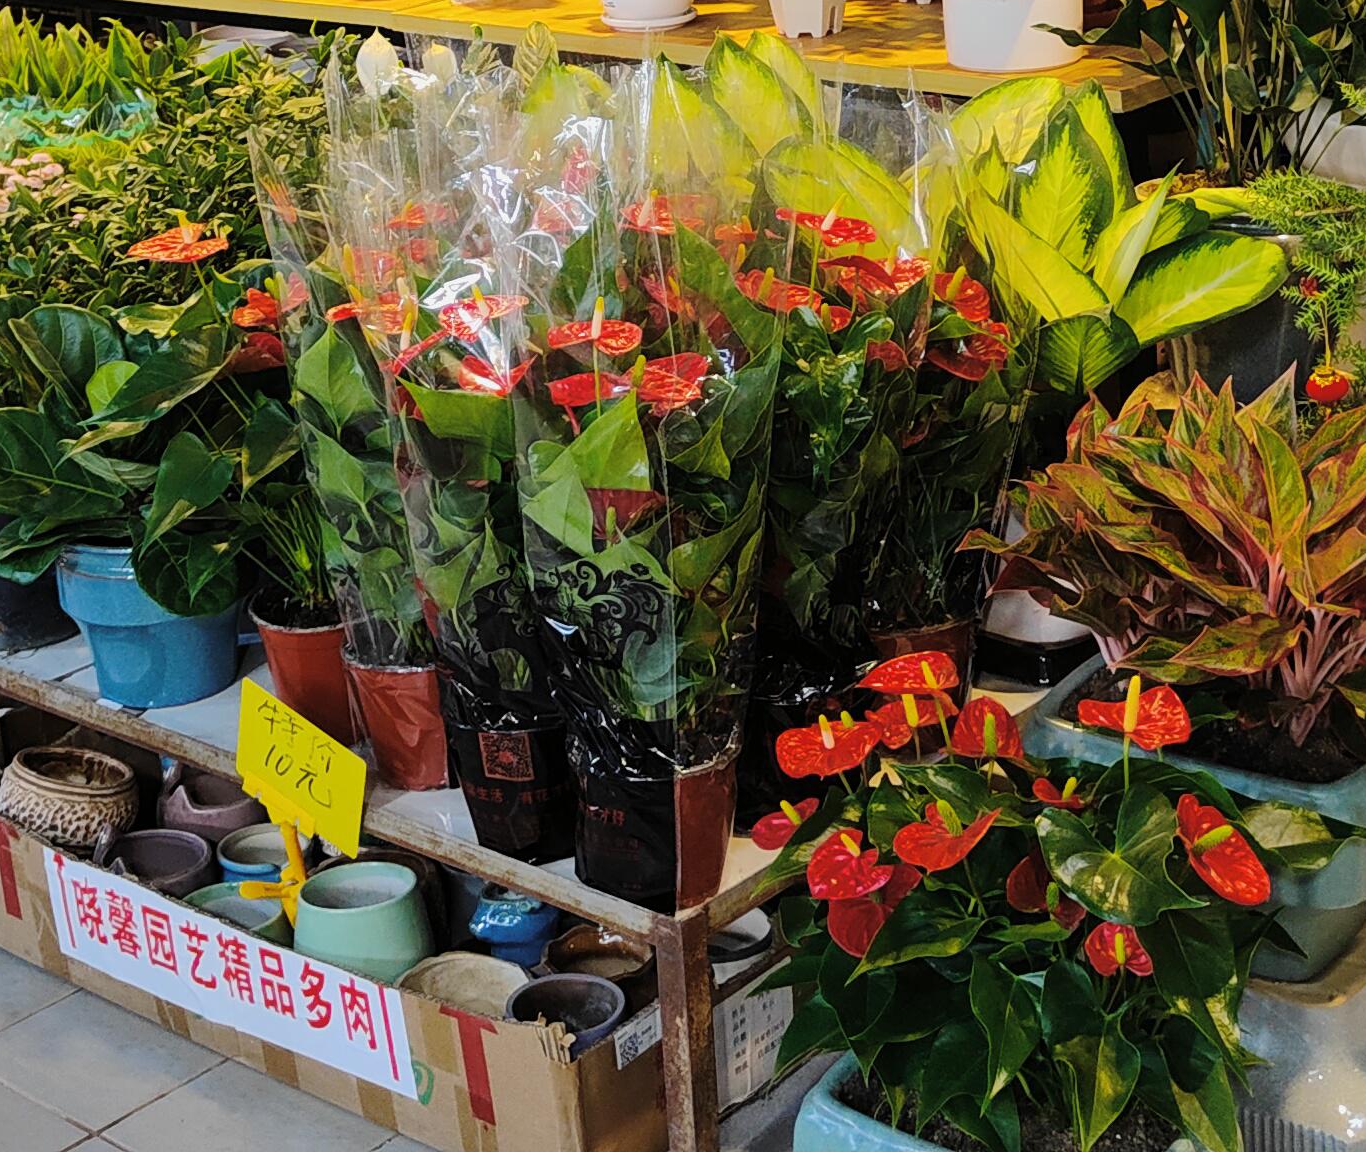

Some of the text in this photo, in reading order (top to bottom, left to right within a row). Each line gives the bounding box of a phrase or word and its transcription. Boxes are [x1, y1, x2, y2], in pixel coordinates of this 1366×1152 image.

[257, 700, 337, 774] 特价
[265, 744, 332, 809] 10元
[70, 876, 377, 1051] 晓馨园艺精品多肉
